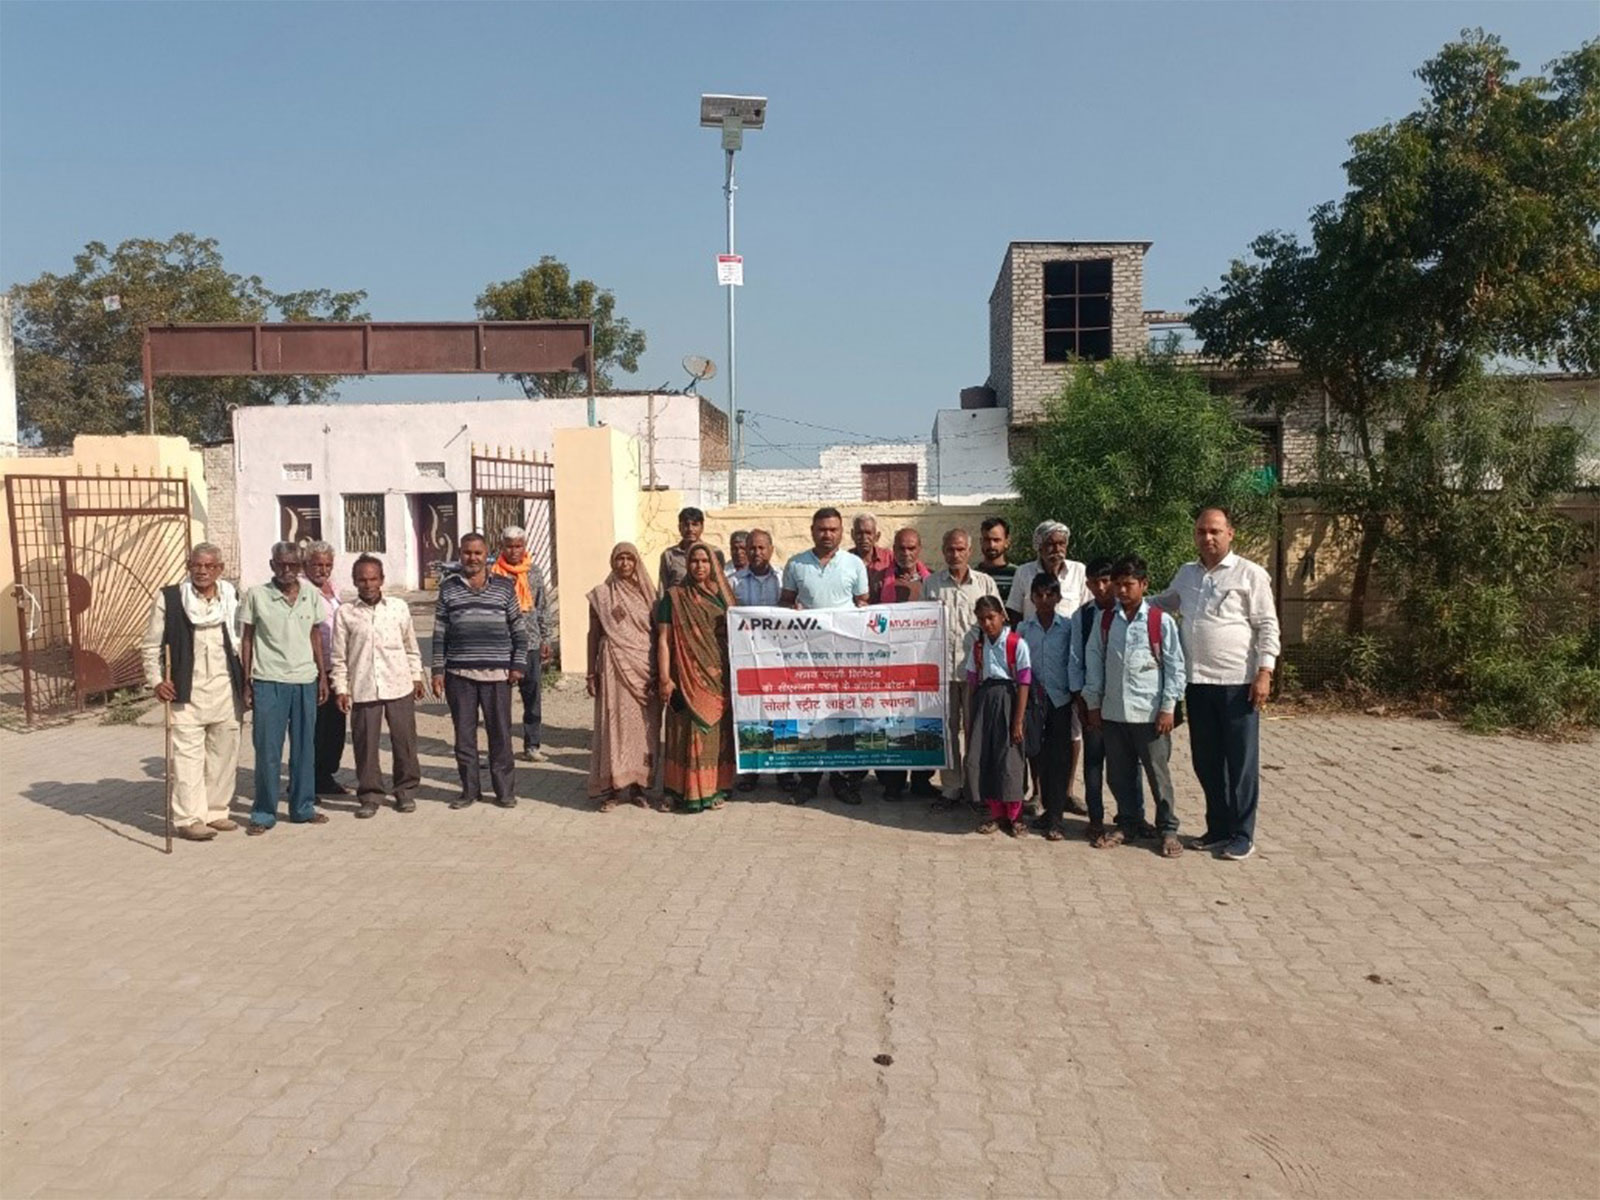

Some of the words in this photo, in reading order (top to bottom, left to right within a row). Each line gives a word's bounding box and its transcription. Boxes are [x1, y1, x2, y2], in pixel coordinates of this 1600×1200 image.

[738, 617, 822, 631] APRAAVA
[763, 698, 791, 711] सोलर
[795, 697, 821, 712] स्ट्रीट
[826, 696, 856, 710] लाइटों
[861, 696, 875, 709] की
[879, 697, 915, 709] स्थापना
